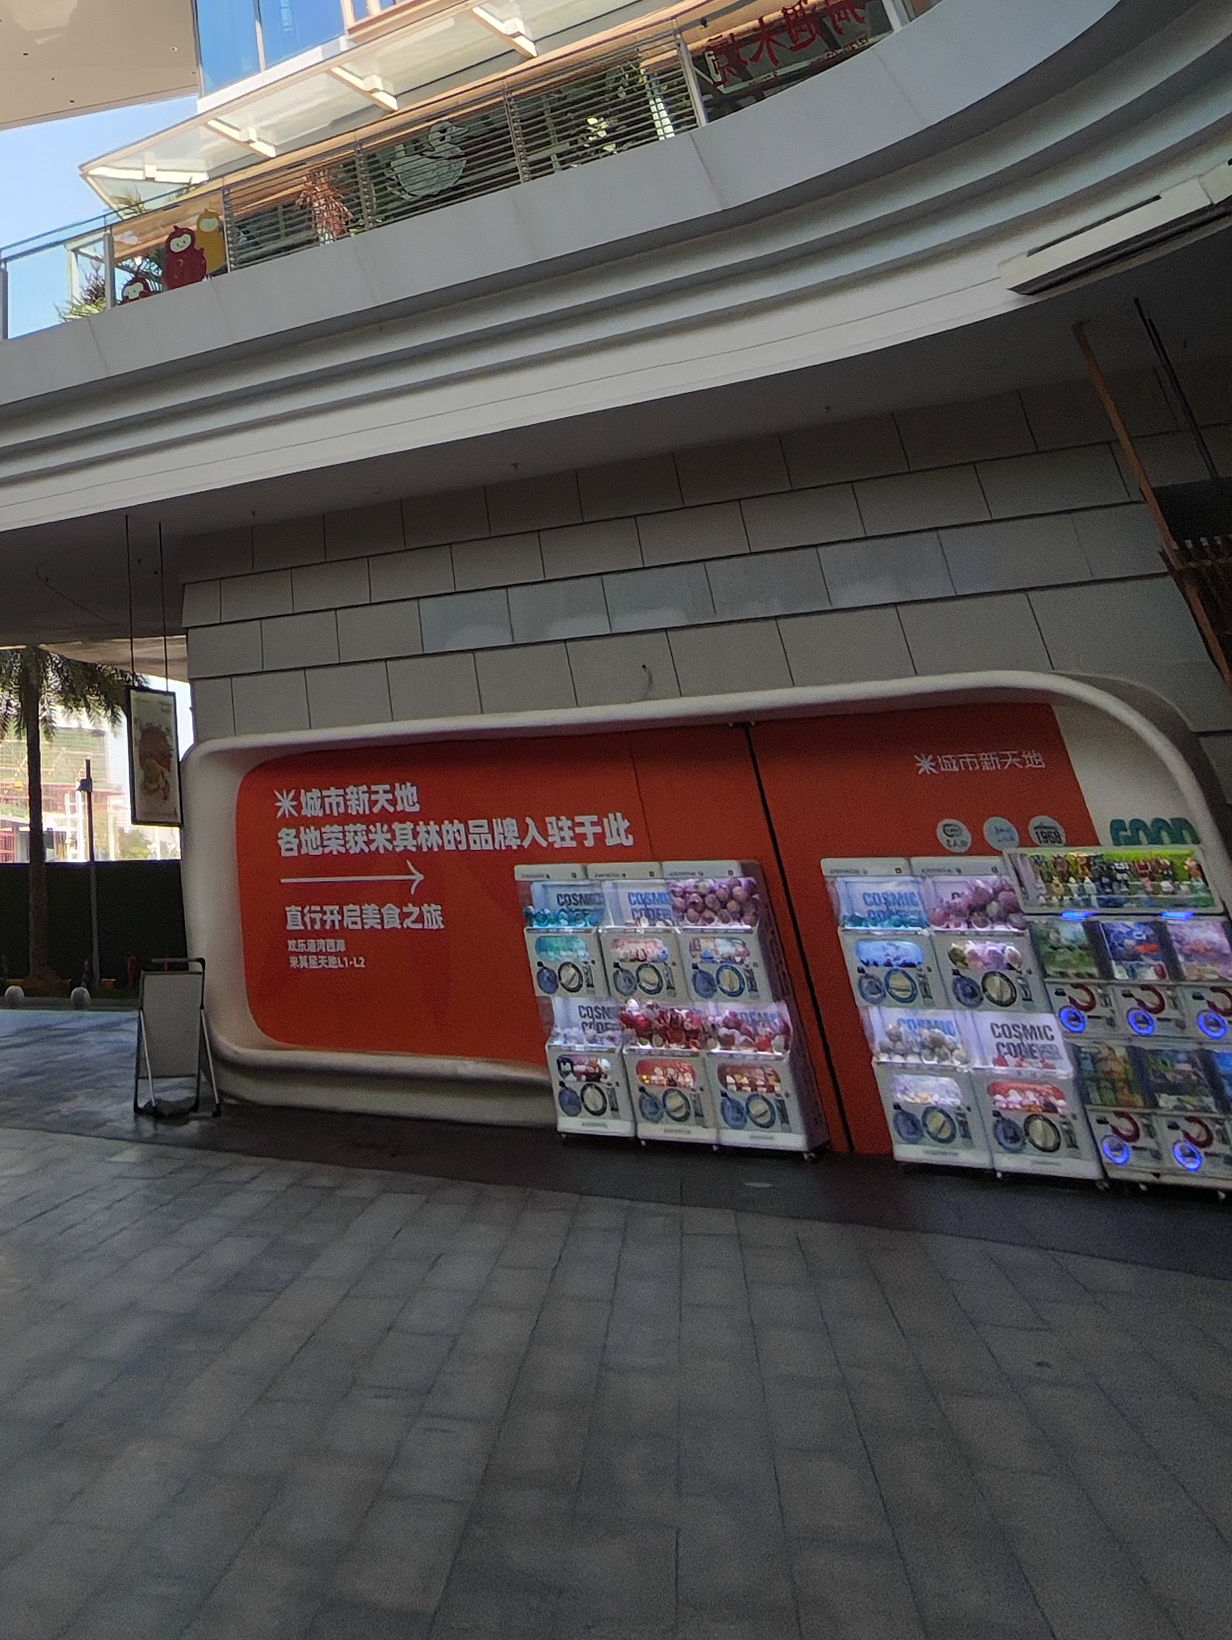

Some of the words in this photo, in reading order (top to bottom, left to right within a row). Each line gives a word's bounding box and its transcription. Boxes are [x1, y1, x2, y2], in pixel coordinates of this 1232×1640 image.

[300, 781, 421, 817] 城市新天地
[277, 812, 634, 857] 各地荣获米其林的品牌入驻于此
[285, 904, 445, 930] 直行开启美食之旅
[990, 1022, 1055, 1041] COSMIC
